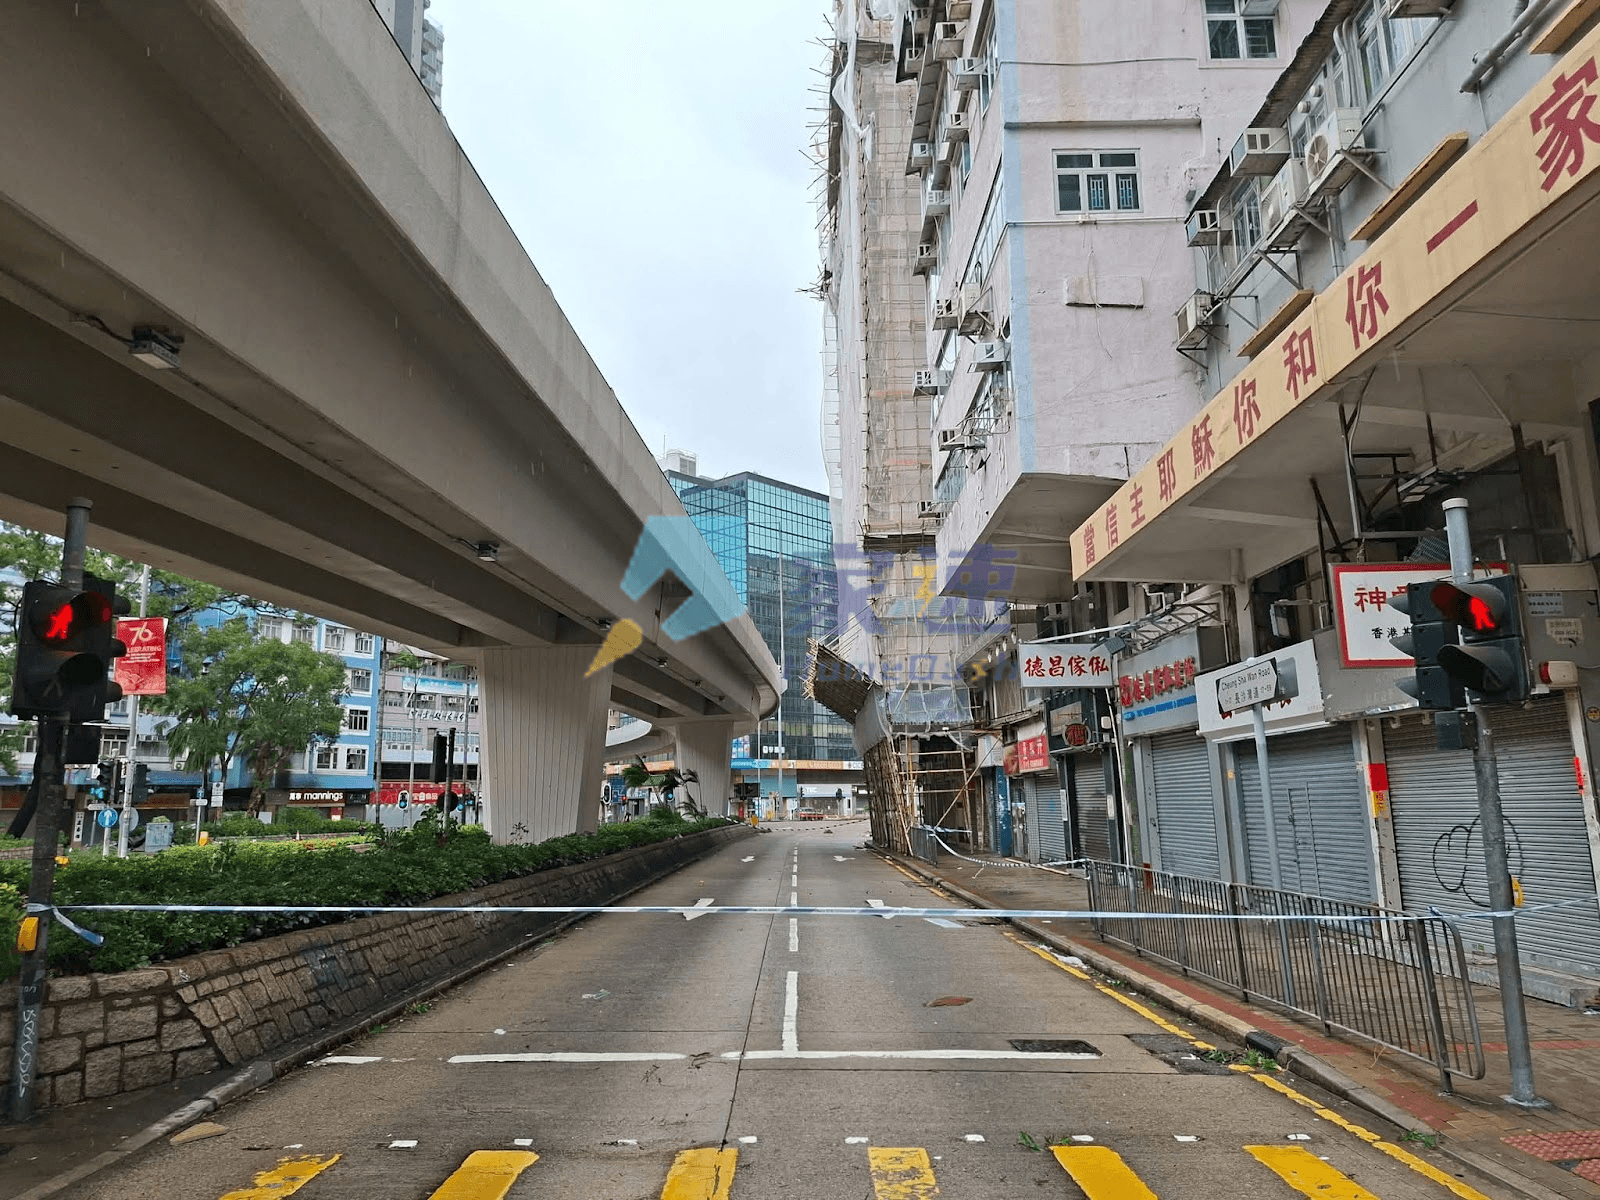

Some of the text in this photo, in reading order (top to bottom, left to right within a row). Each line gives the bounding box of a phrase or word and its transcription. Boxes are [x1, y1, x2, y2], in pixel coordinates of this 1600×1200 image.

[1083, 54, 1600, 567] 當信主耶穌你和你一家
[1024, 655, 1110, 677] 德昌傢俬
[1221, 667, 1271, 691] Cheung Sha Wan Road
[303, 791, 344, 801] mannings
